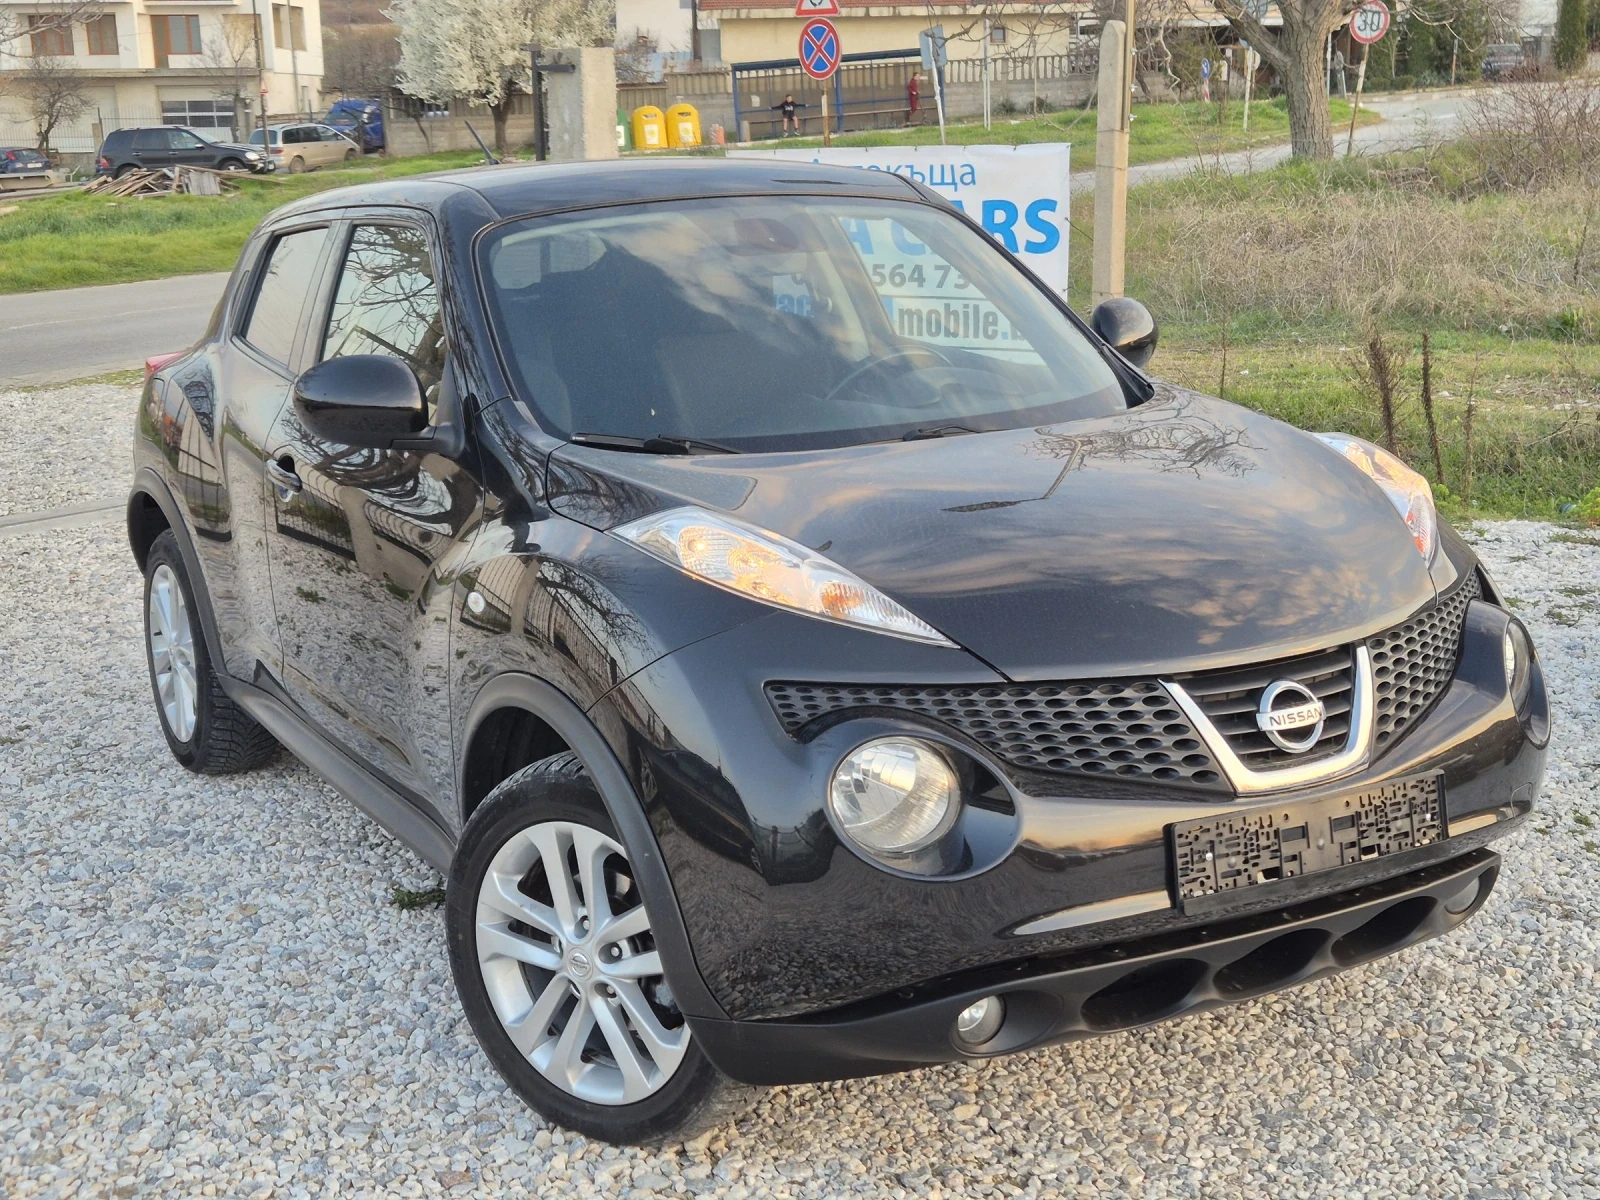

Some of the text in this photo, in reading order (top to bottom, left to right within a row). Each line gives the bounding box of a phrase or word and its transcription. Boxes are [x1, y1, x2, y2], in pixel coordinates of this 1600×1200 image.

[1358, 10, 1381, 32] 30
[890, 198, 1061, 256] CRS
[871, 263, 926, 289] 564
[1269, 706, 1323, 727] NISSAN
